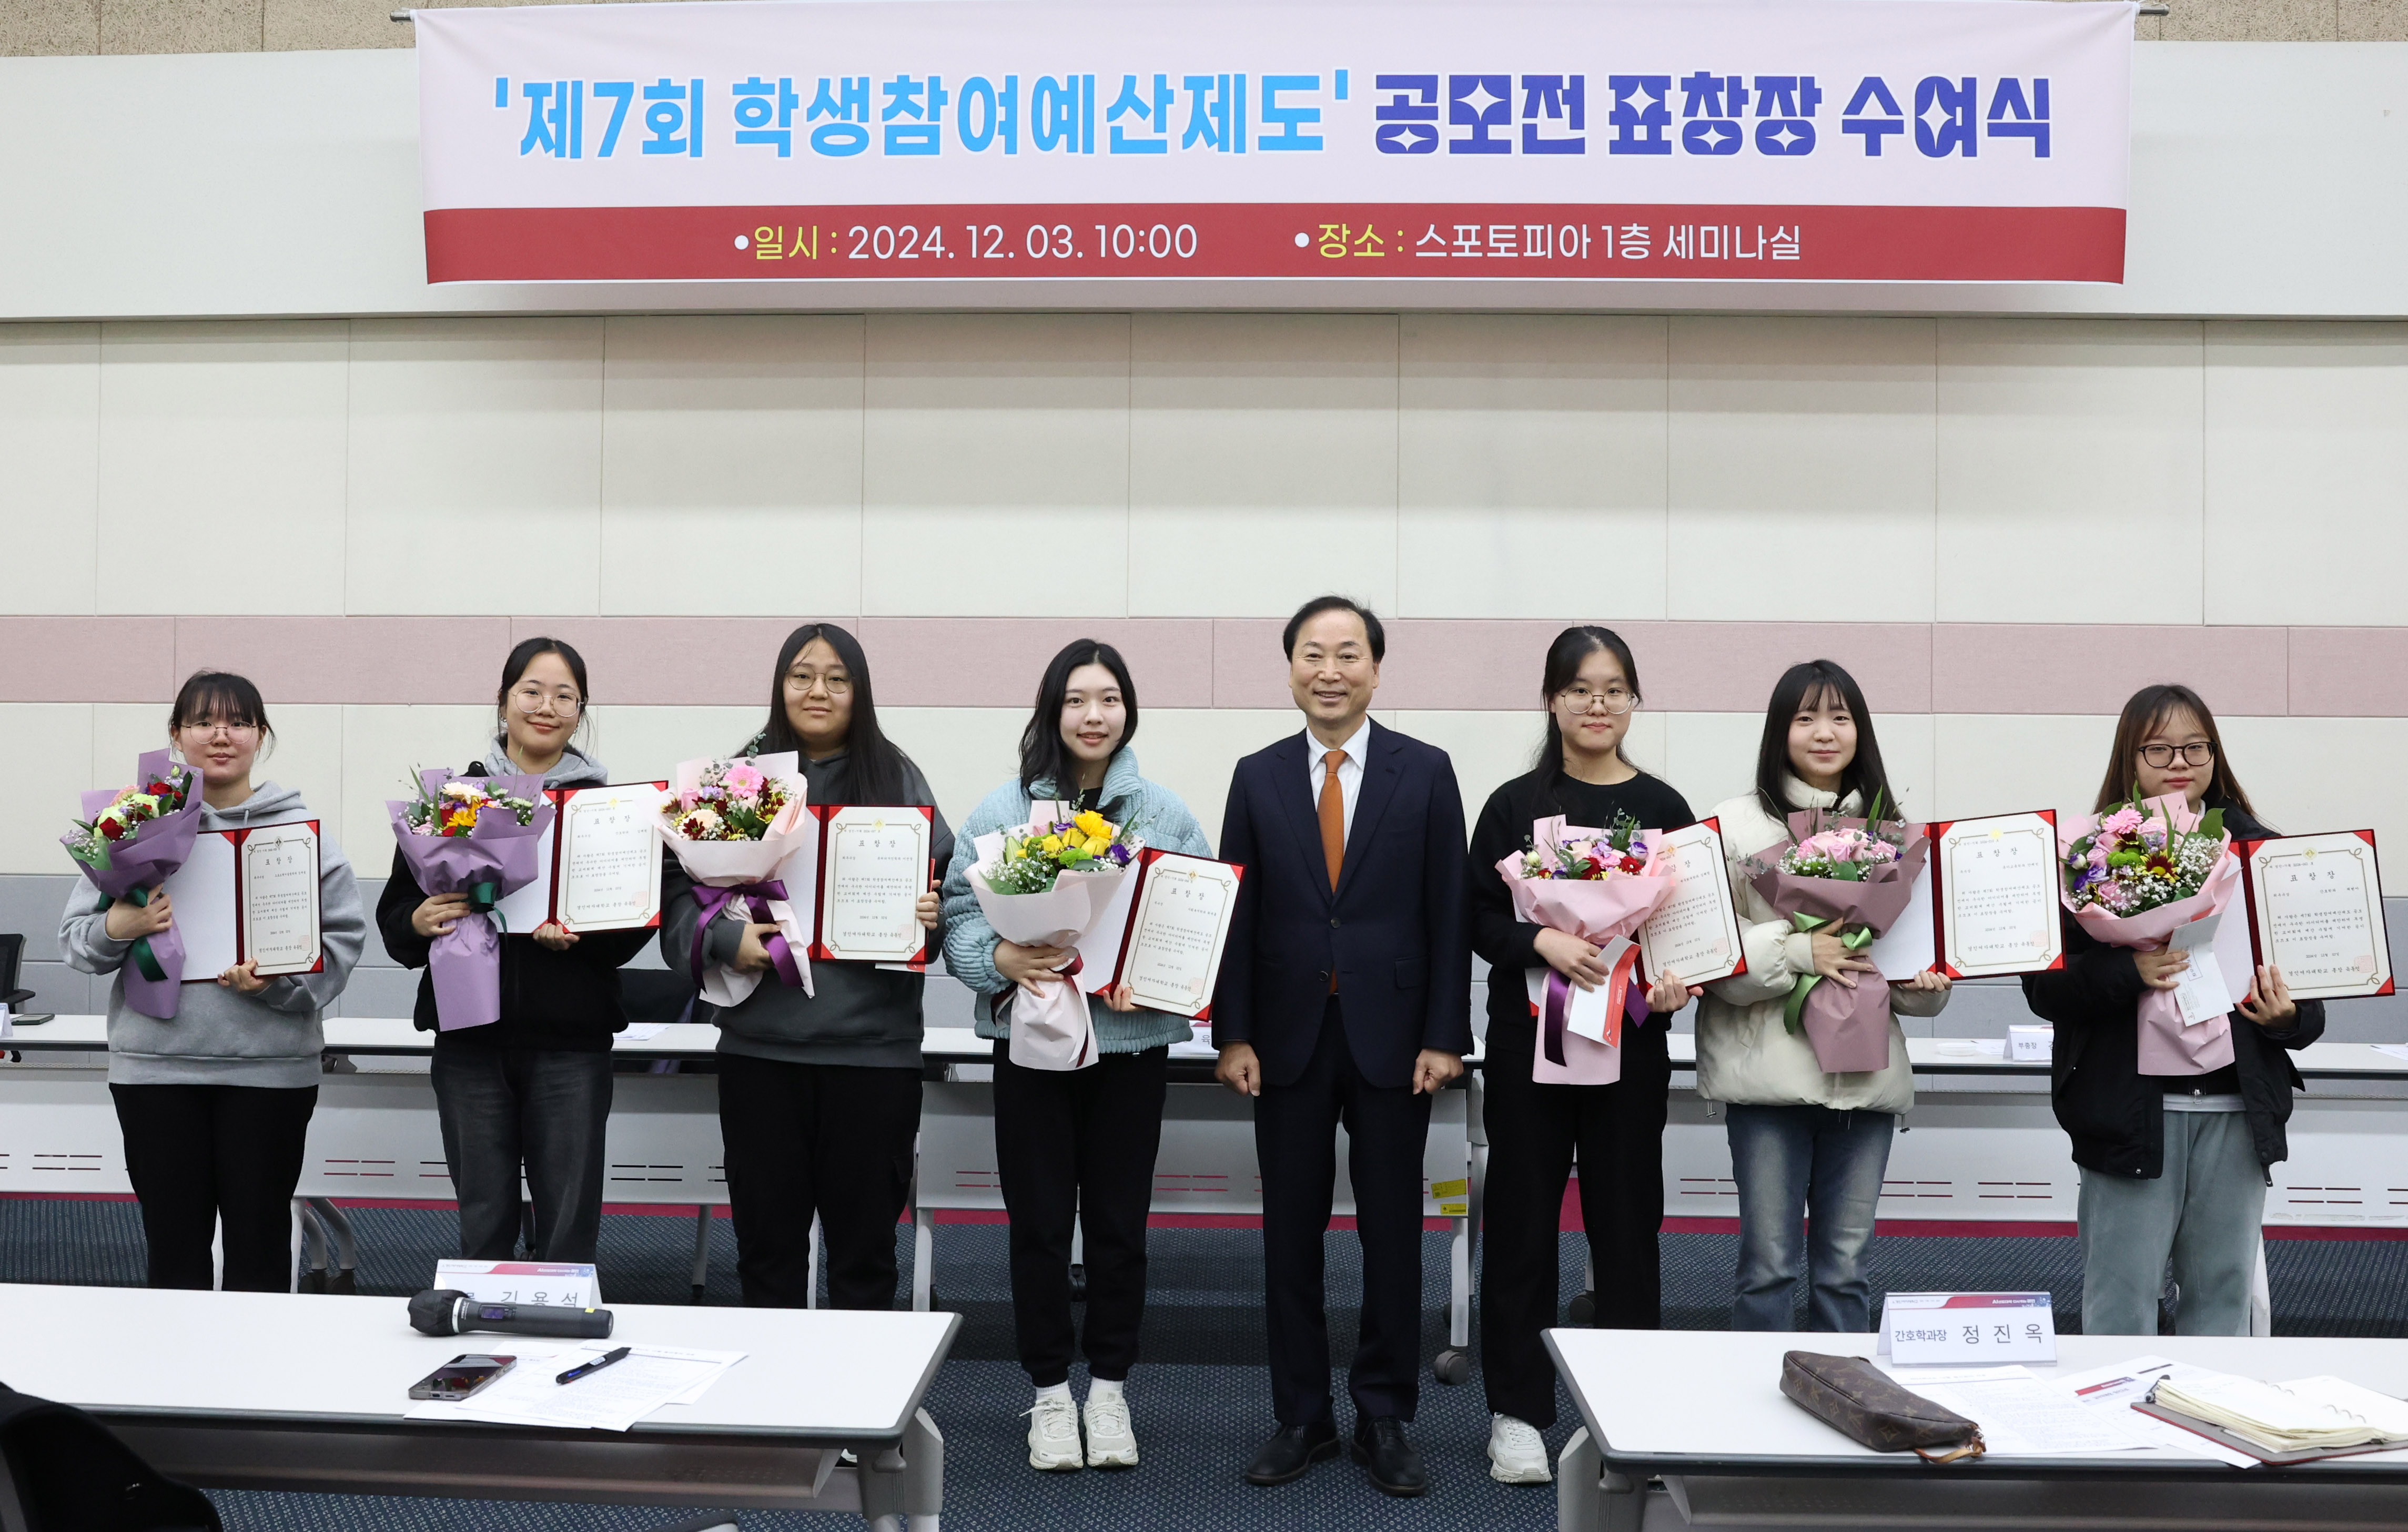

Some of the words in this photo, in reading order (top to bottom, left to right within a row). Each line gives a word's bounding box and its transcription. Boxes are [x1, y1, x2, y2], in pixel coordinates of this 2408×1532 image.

[1375, 74, 1586, 155] 공모전
[1609, 72, 1822, 156] 표창장
[1842, 76, 2050, 158] 수여식
[848, 225, 954, 259] 2024.
[964, 225, 1015, 259] 12.
[1026, 225, 1084, 259] 03.
[1094, 224, 1197, 259] 10:00
[1415, 224, 1593, 259] 스포토피아
[1600, 224, 1651, 259] 1층
[1663, 224, 1801, 261] 세미나실
[1895, 1330, 1947, 1342] 간호학과장
